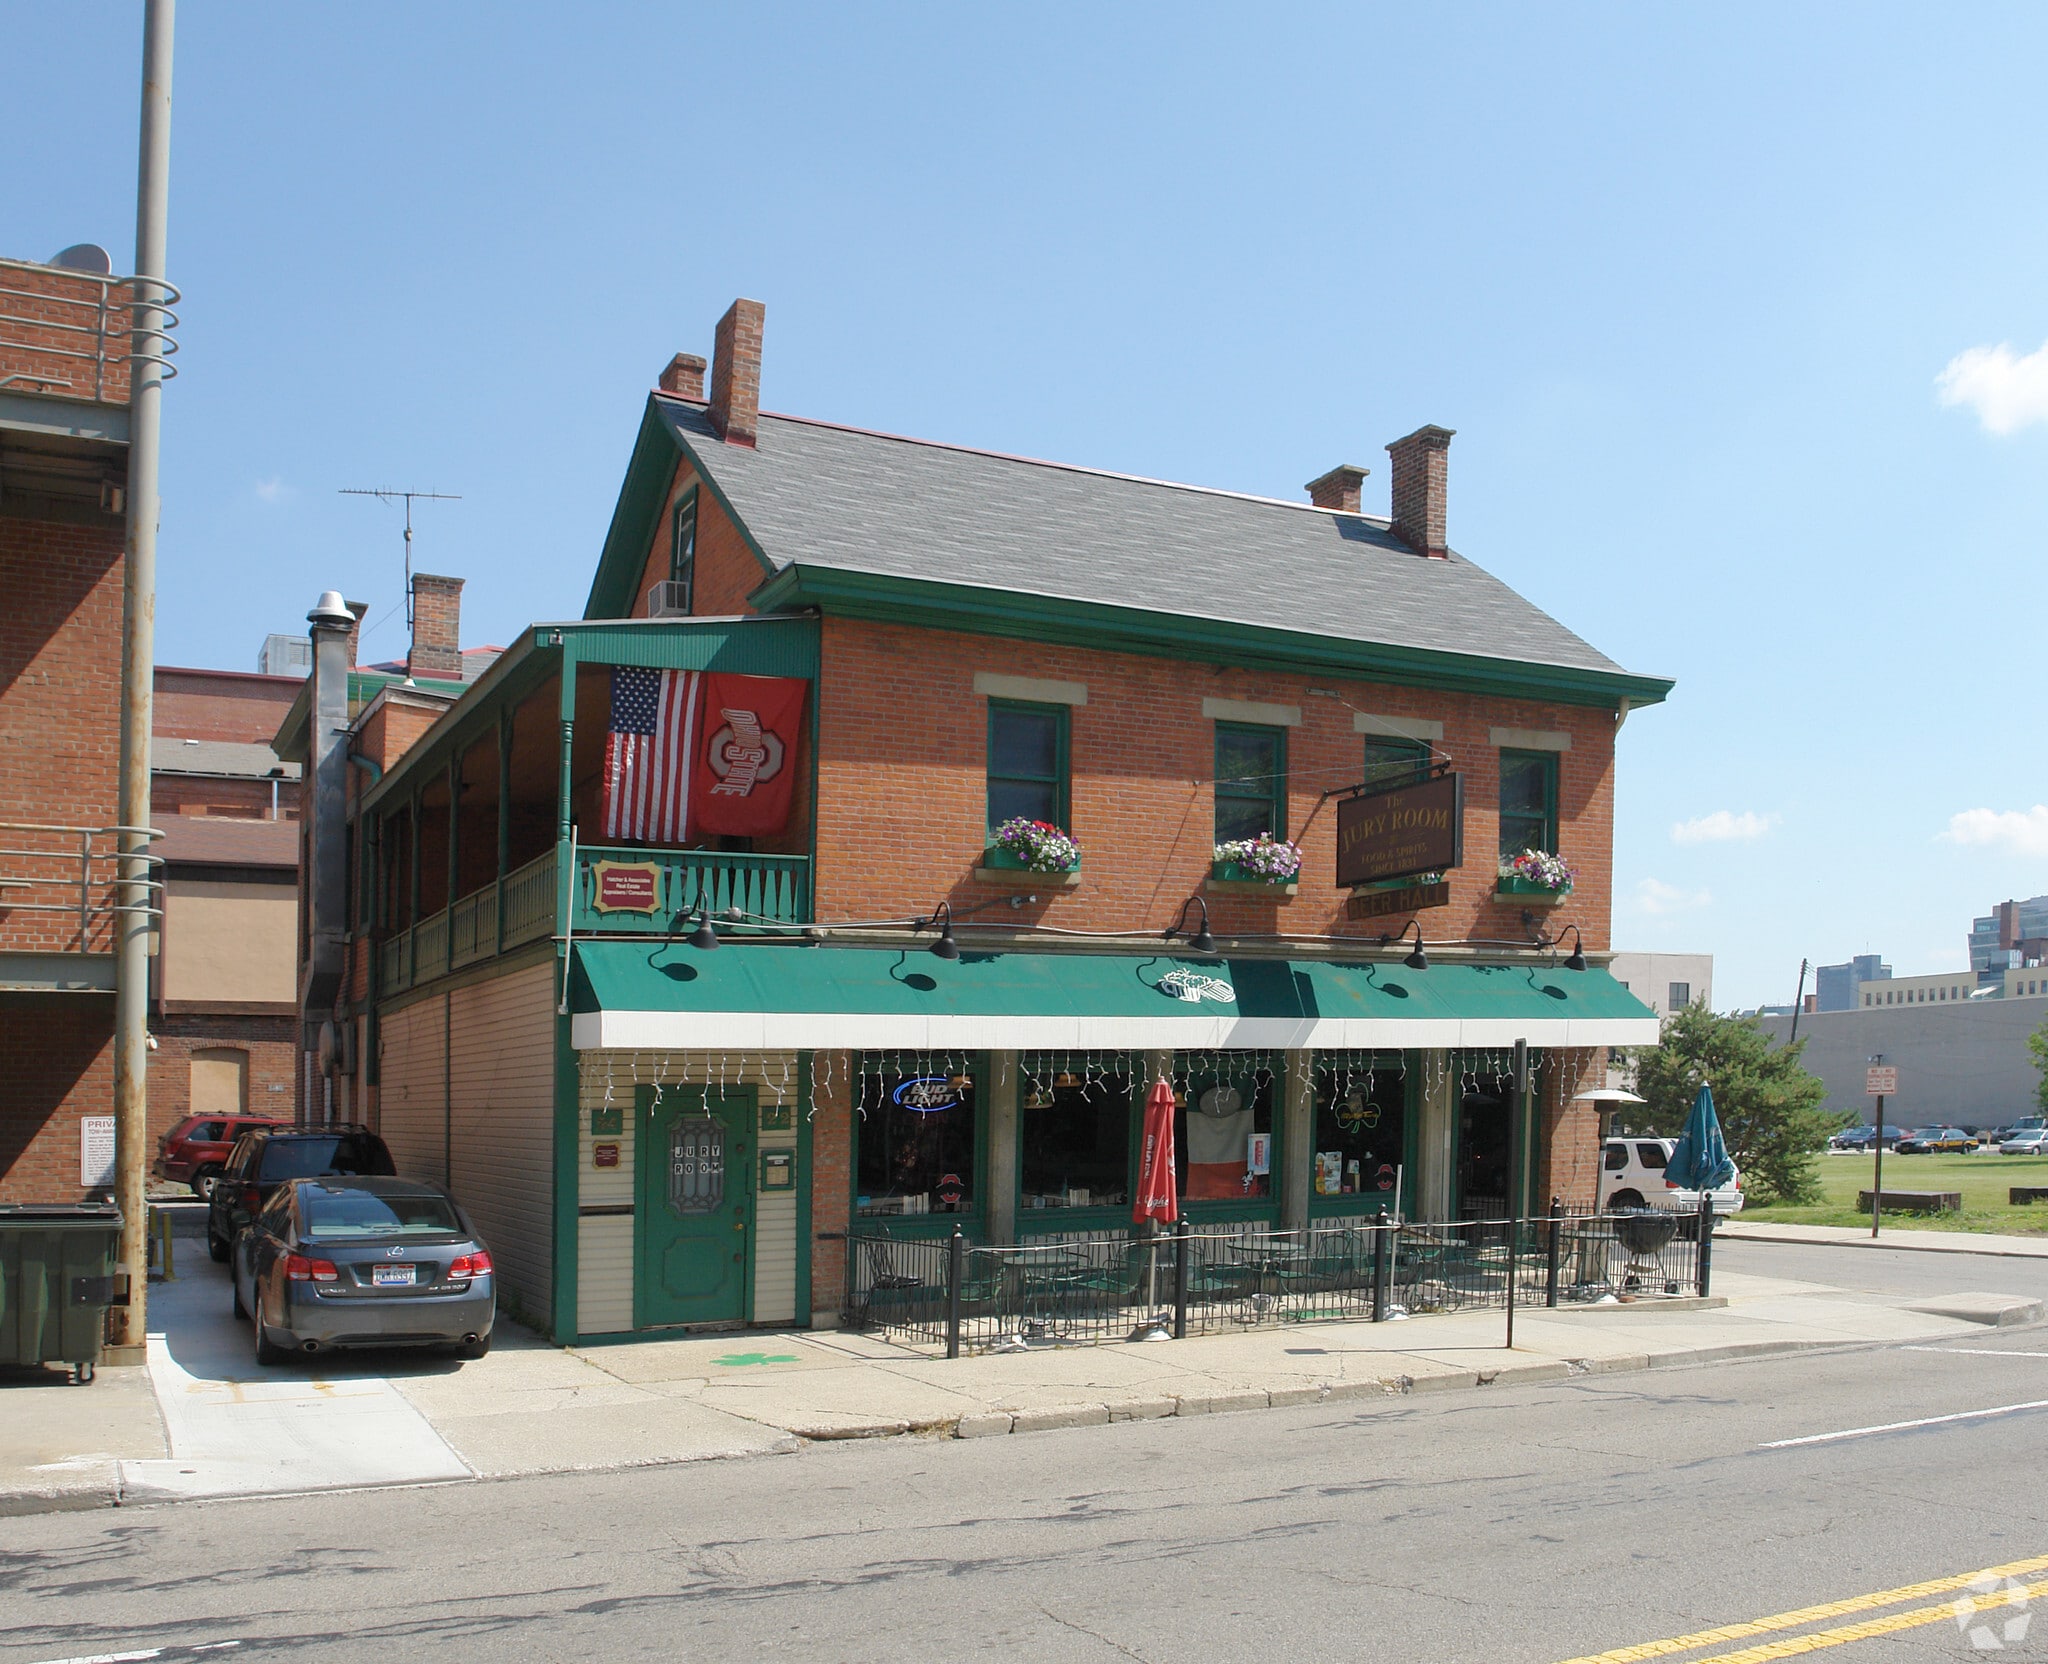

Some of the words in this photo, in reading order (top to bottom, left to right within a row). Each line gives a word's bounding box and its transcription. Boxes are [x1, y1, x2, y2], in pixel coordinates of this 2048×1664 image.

[721, 708, 761, 749] OHIO
[710, 746, 766, 797] STATE
[1342, 813, 1386, 854] JURY
[1391, 807, 1449, 831] ROOM
[911, 1083, 948, 1095] BUD
[902, 1093, 955, 1105] LIGHT
[675, 1145, 720, 1157] JURY
[675, 1163, 719, 1174] ROOM
